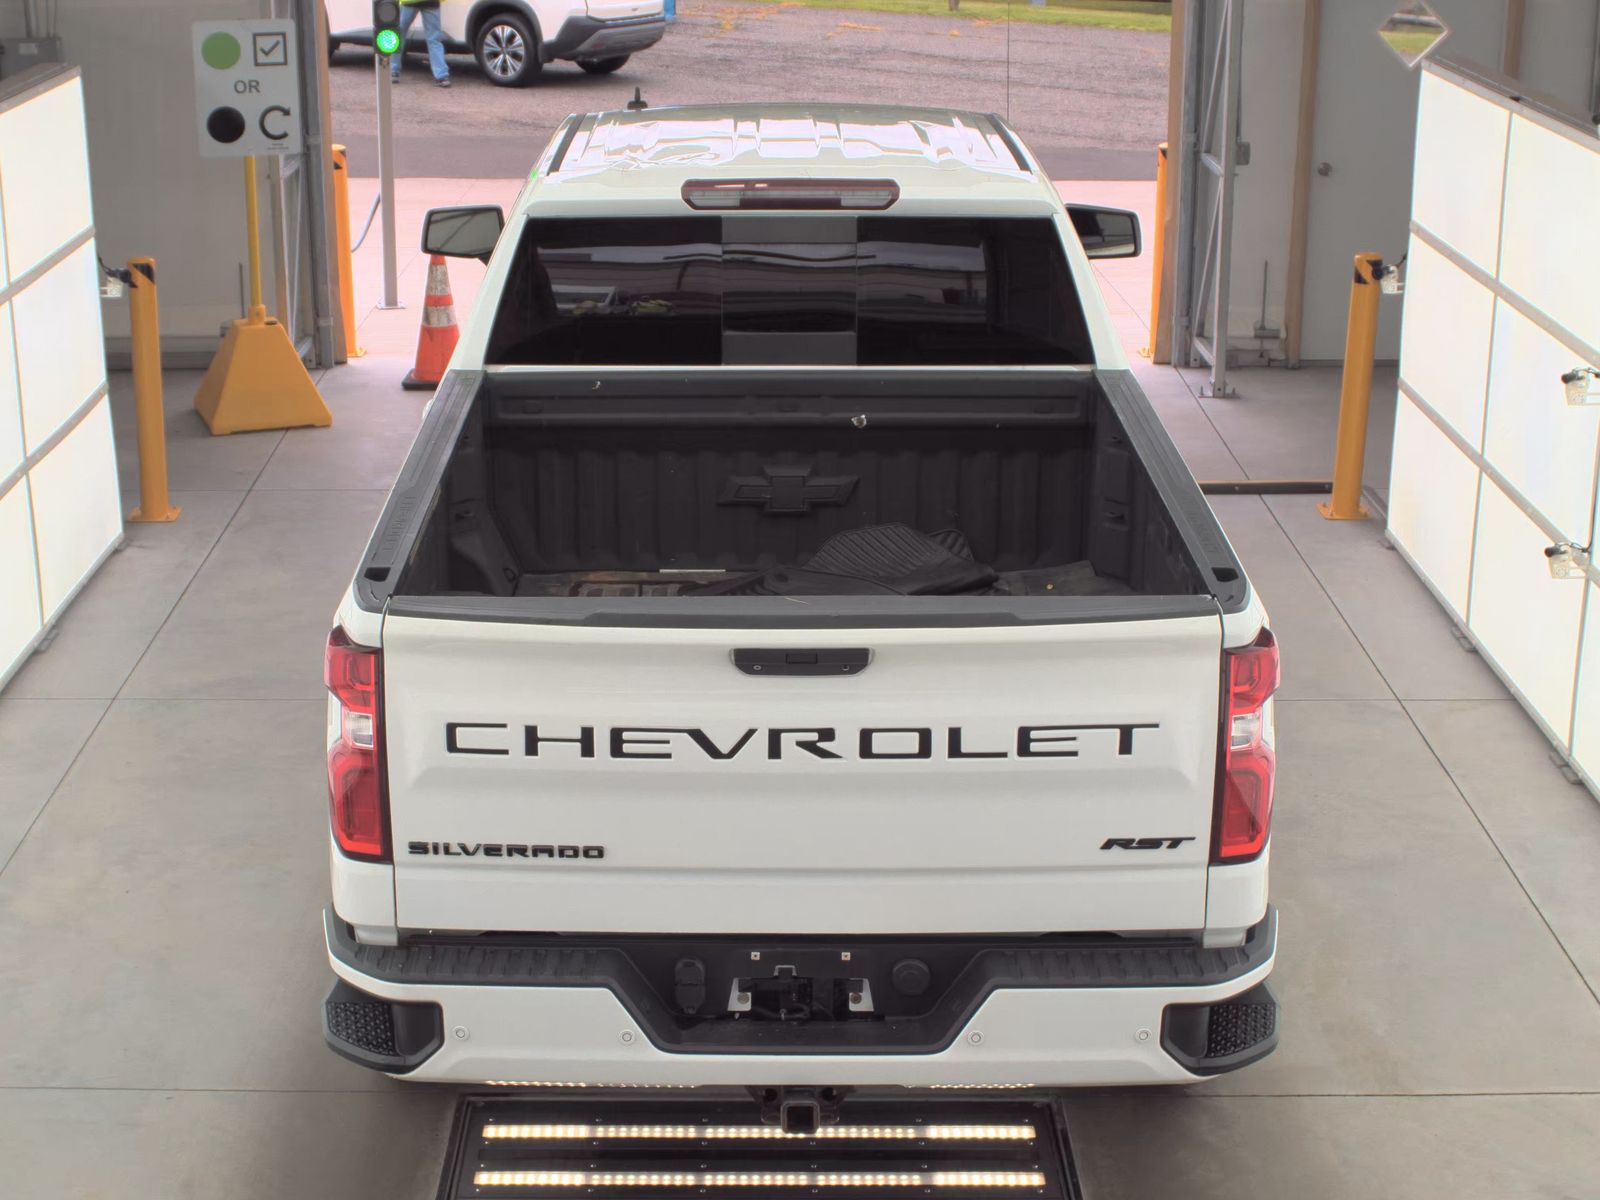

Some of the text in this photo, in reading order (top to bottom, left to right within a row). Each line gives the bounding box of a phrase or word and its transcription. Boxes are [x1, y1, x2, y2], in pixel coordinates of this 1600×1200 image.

[234, 79, 261, 94] OR
[446, 722, 1160, 760] CHEVROLET
[408, 841, 605, 859] SILVERADO
[1099, 837, 1196, 850] RST
